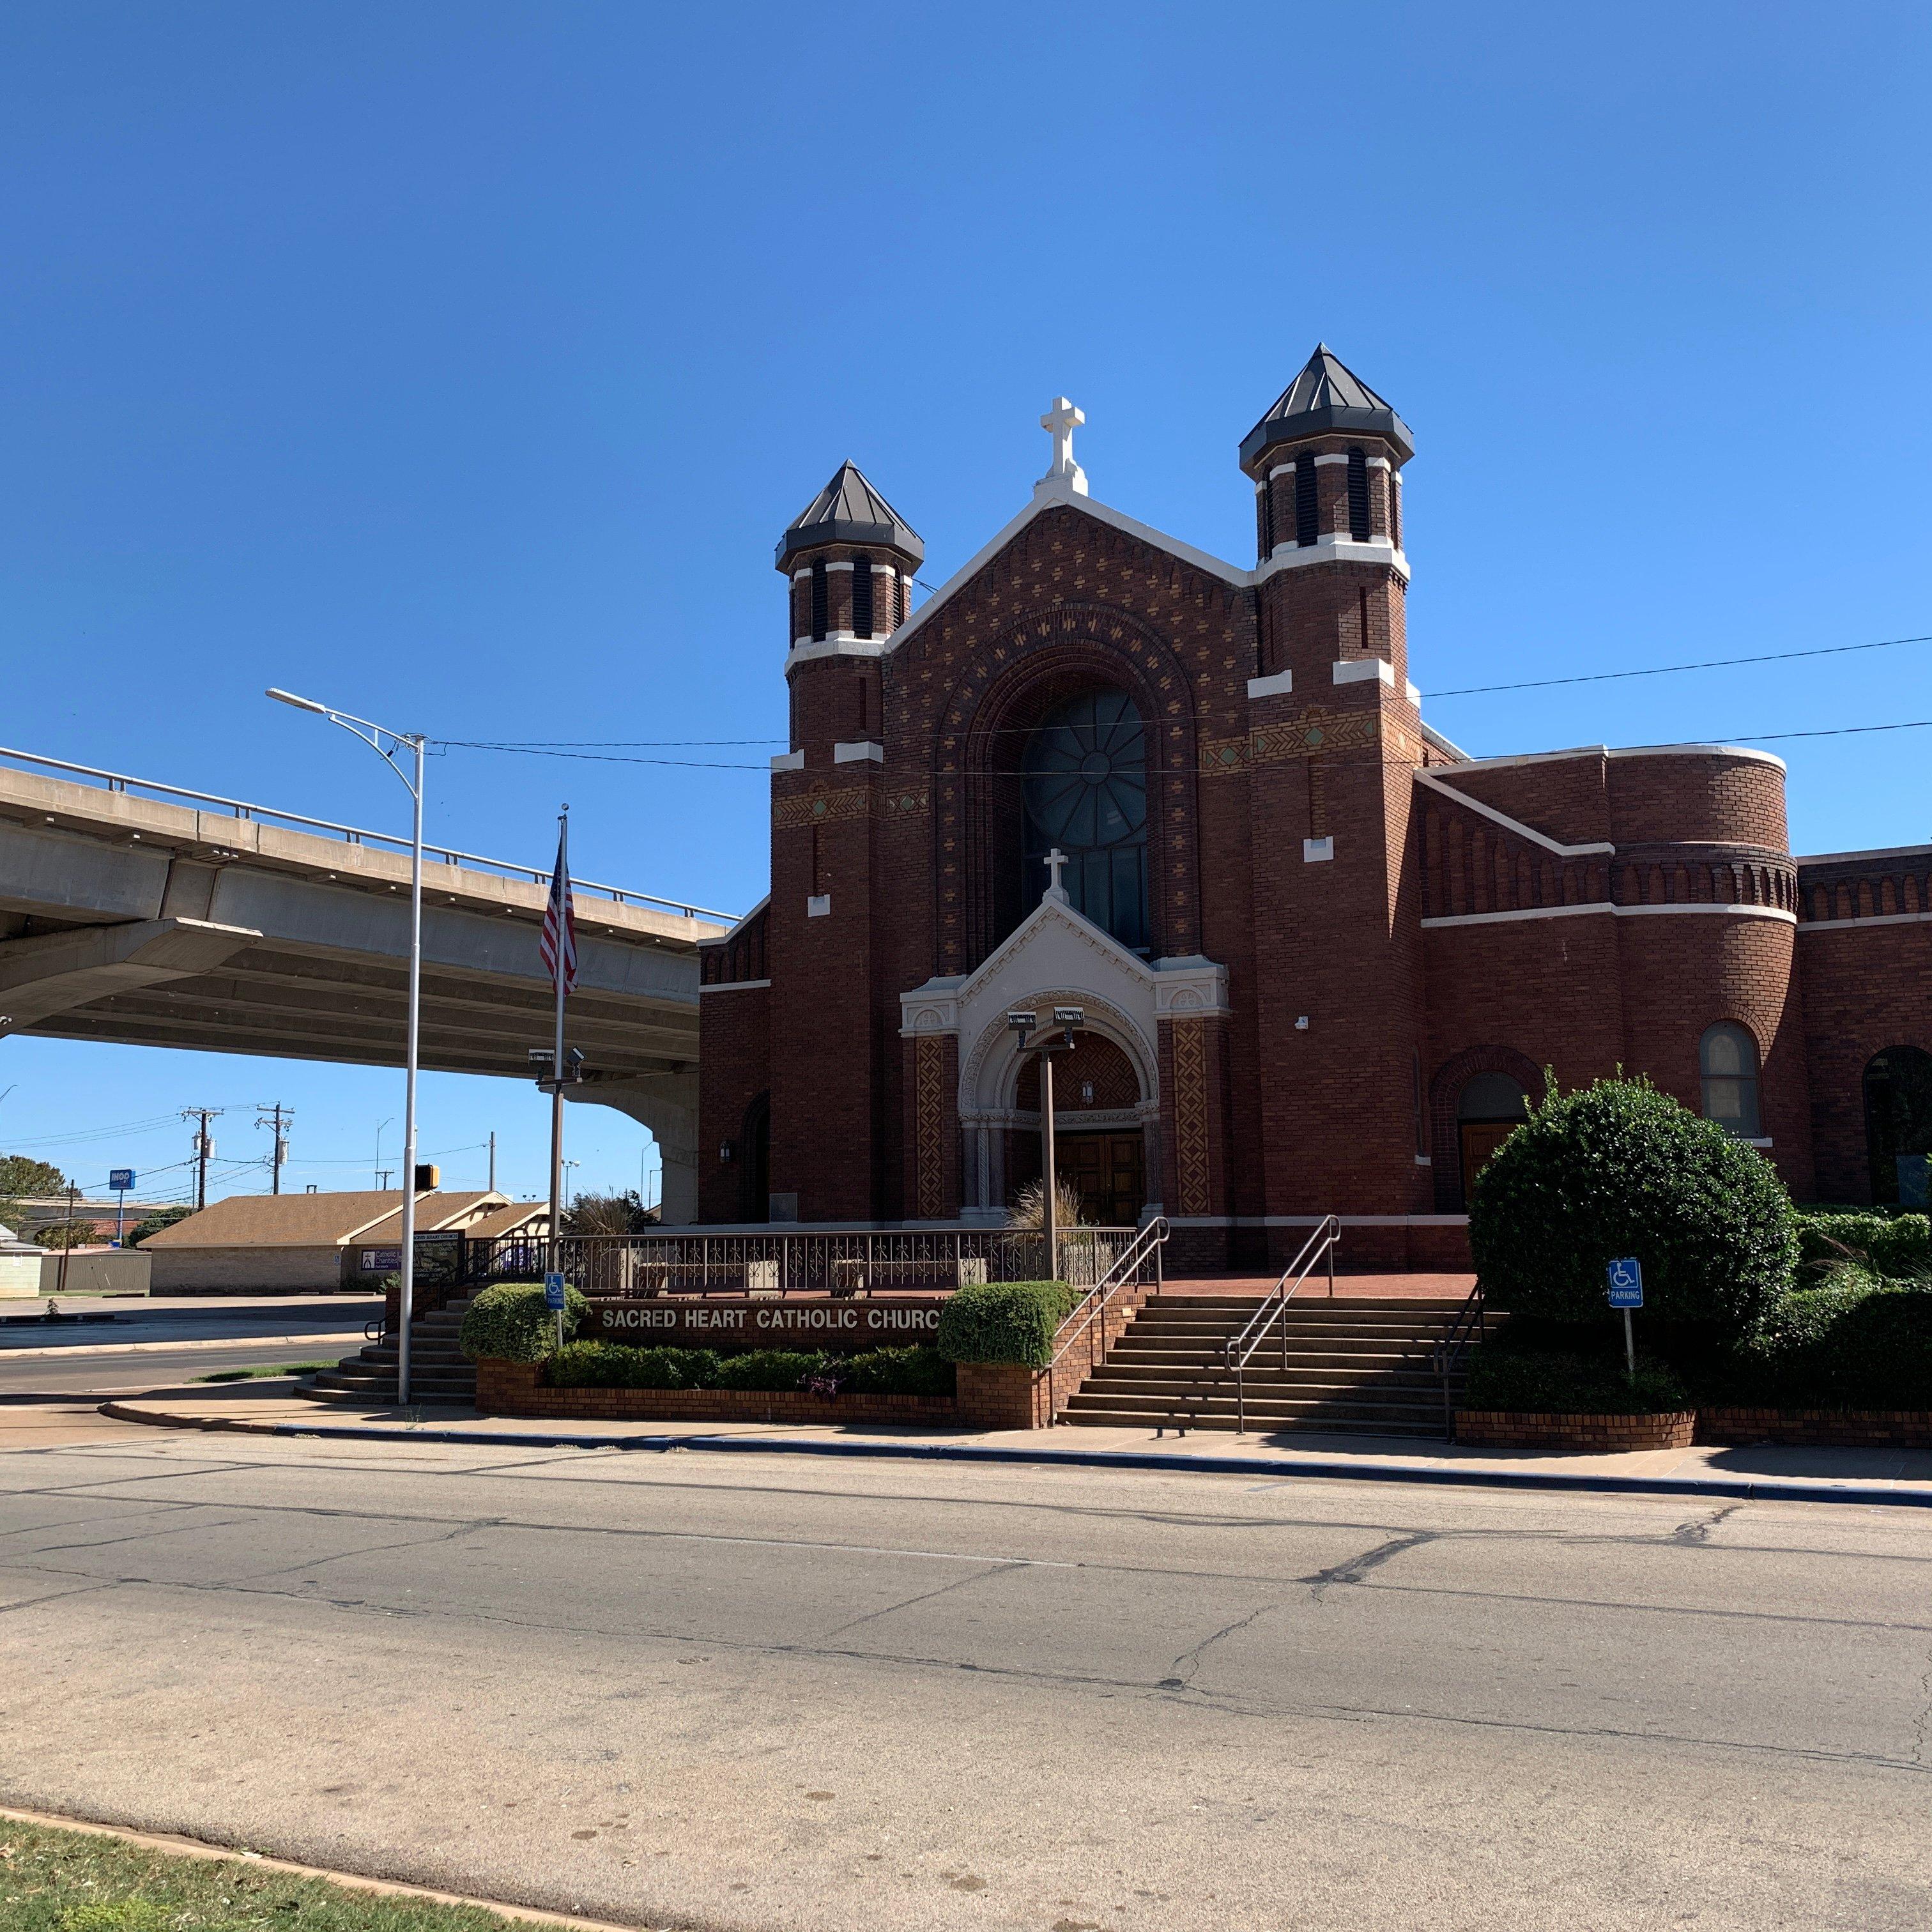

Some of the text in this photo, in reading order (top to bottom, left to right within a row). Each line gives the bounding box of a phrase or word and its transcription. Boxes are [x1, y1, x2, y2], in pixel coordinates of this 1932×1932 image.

[1611, 1291, 1640, 1300] PARKING
[602, 1309, 944, 1329] SACRED HEART CATHOLIC CHURC
